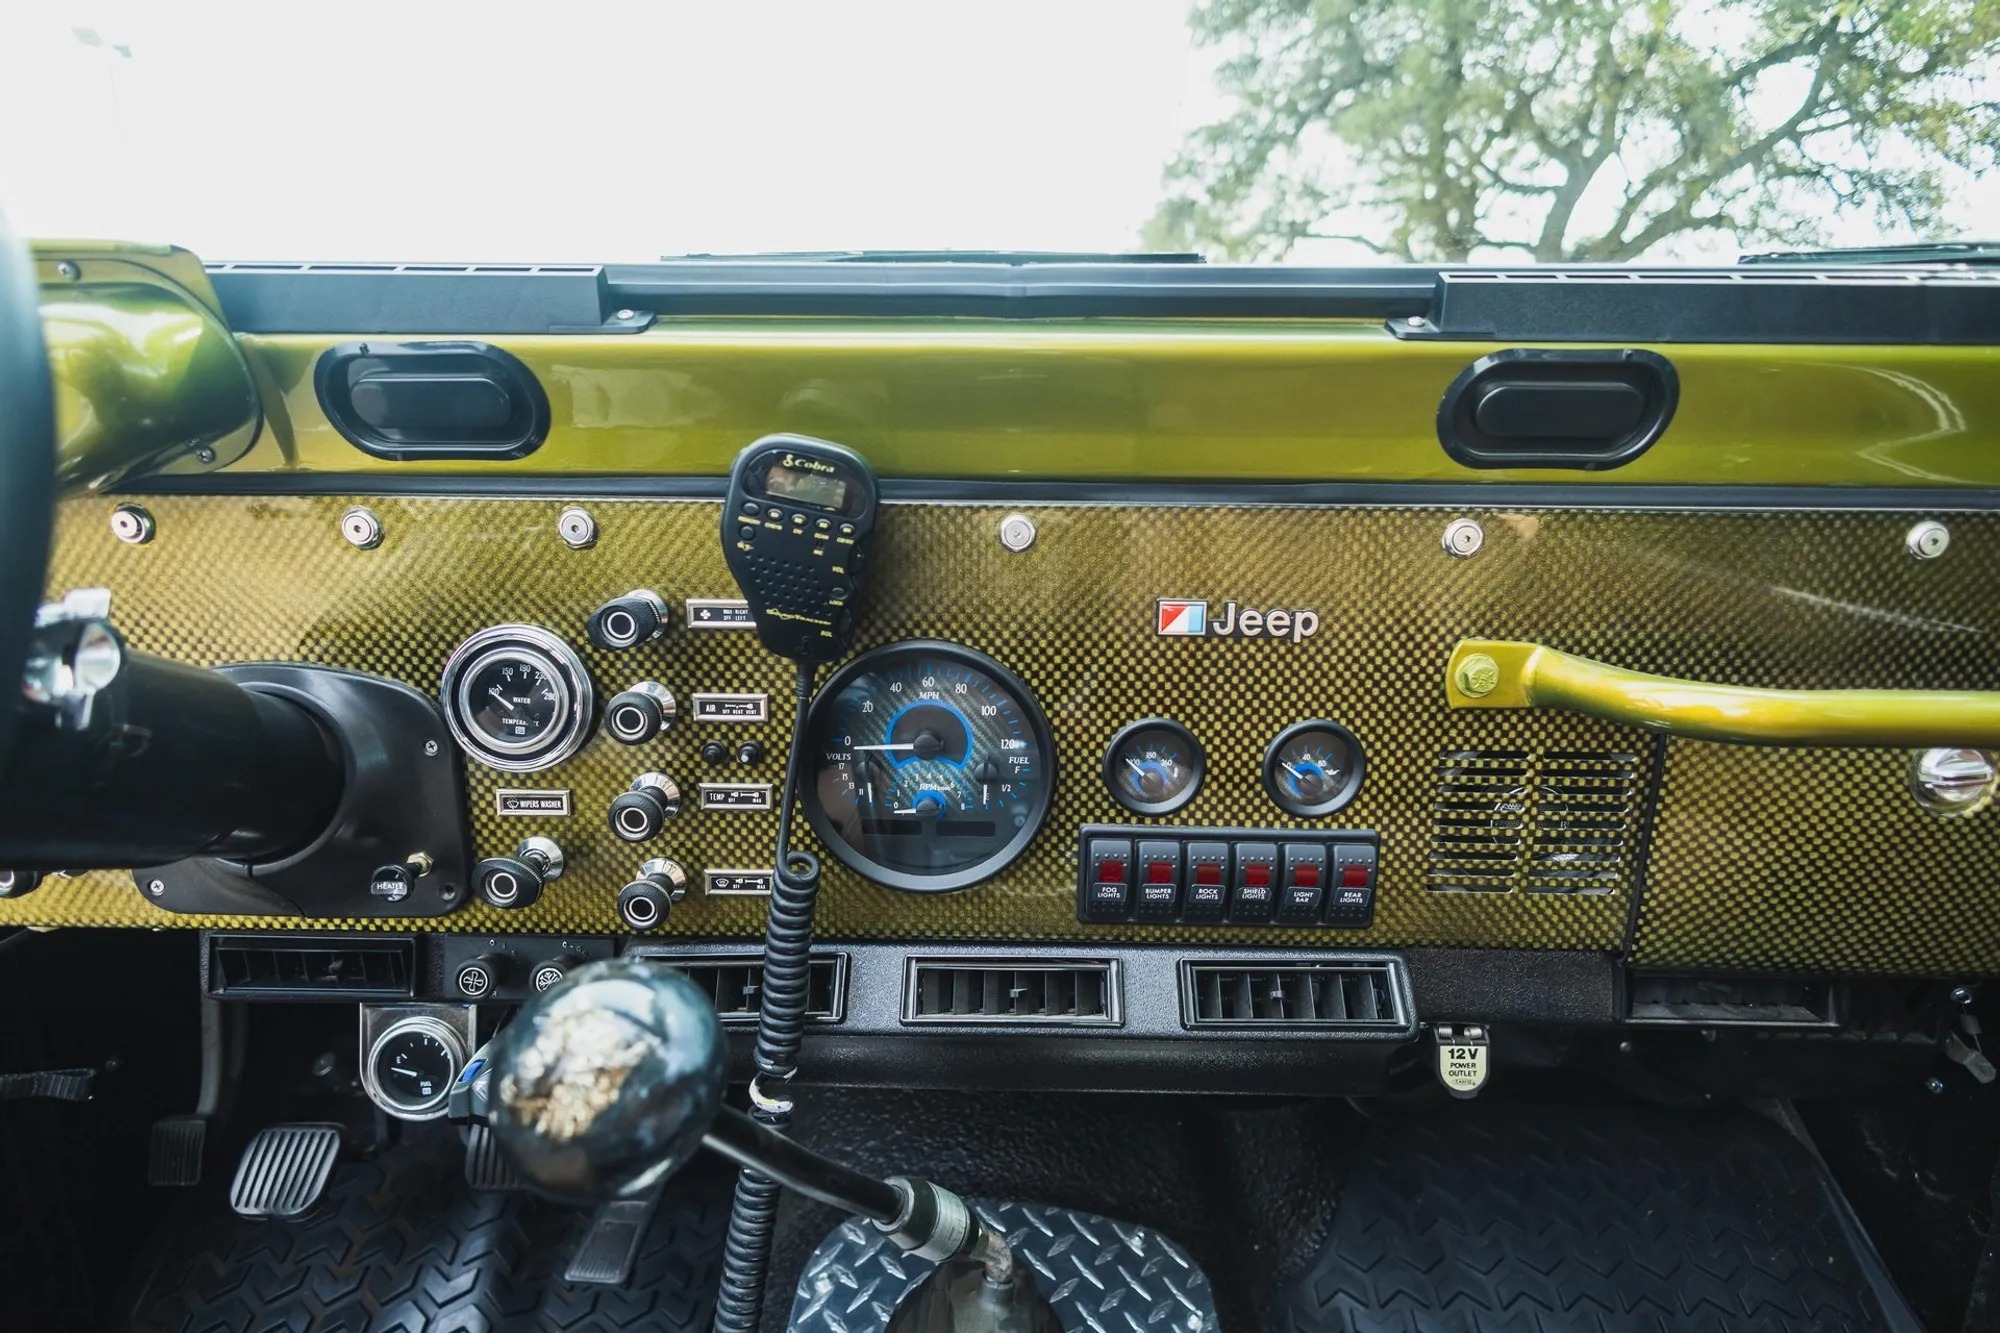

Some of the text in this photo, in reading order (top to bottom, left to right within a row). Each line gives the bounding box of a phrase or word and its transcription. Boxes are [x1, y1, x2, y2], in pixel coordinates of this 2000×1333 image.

[795, 459, 835, 474] Cobra
[1212, 602, 1319, 643] Jeep
[502, 667, 514, 676] 150
[922, 676, 935, 687] 60
[890, 682, 903, 692] 40
[955, 683, 968, 694] 80
[919, 691, 940, 699] MPH
[512, 696, 531, 704] WATER
[705, 704, 716, 713] AIR
[862, 703, 874, 713] 20
[981, 705, 997, 716] 100
[844, 736, 852, 746] 0
[1001, 739, 1015, 749] 120
[826, 752, 852, 761] VOLTS
[1009, 756, 1030, 764] FUEL
[1302, 753, 1311, 761] 40
[1014, 766, 1021, 774] F
[842, 773, 848, 781] 15
[848, 782, 855, 790] 13
[904, 780, 908, 788] 2
[950, 781, 955, 789] 6
[1001, 784, 1012, 792] 1/2
[709, 793, 725, 801] TEMP
[957, 791, 962, 799] 7
[520, 800, 562, 809] WIPERS WASHER
[893, 801, 899, 809] 0
[960, 803, 966, 811] 8
[1243, 887, 1266, 895] SHIELD
